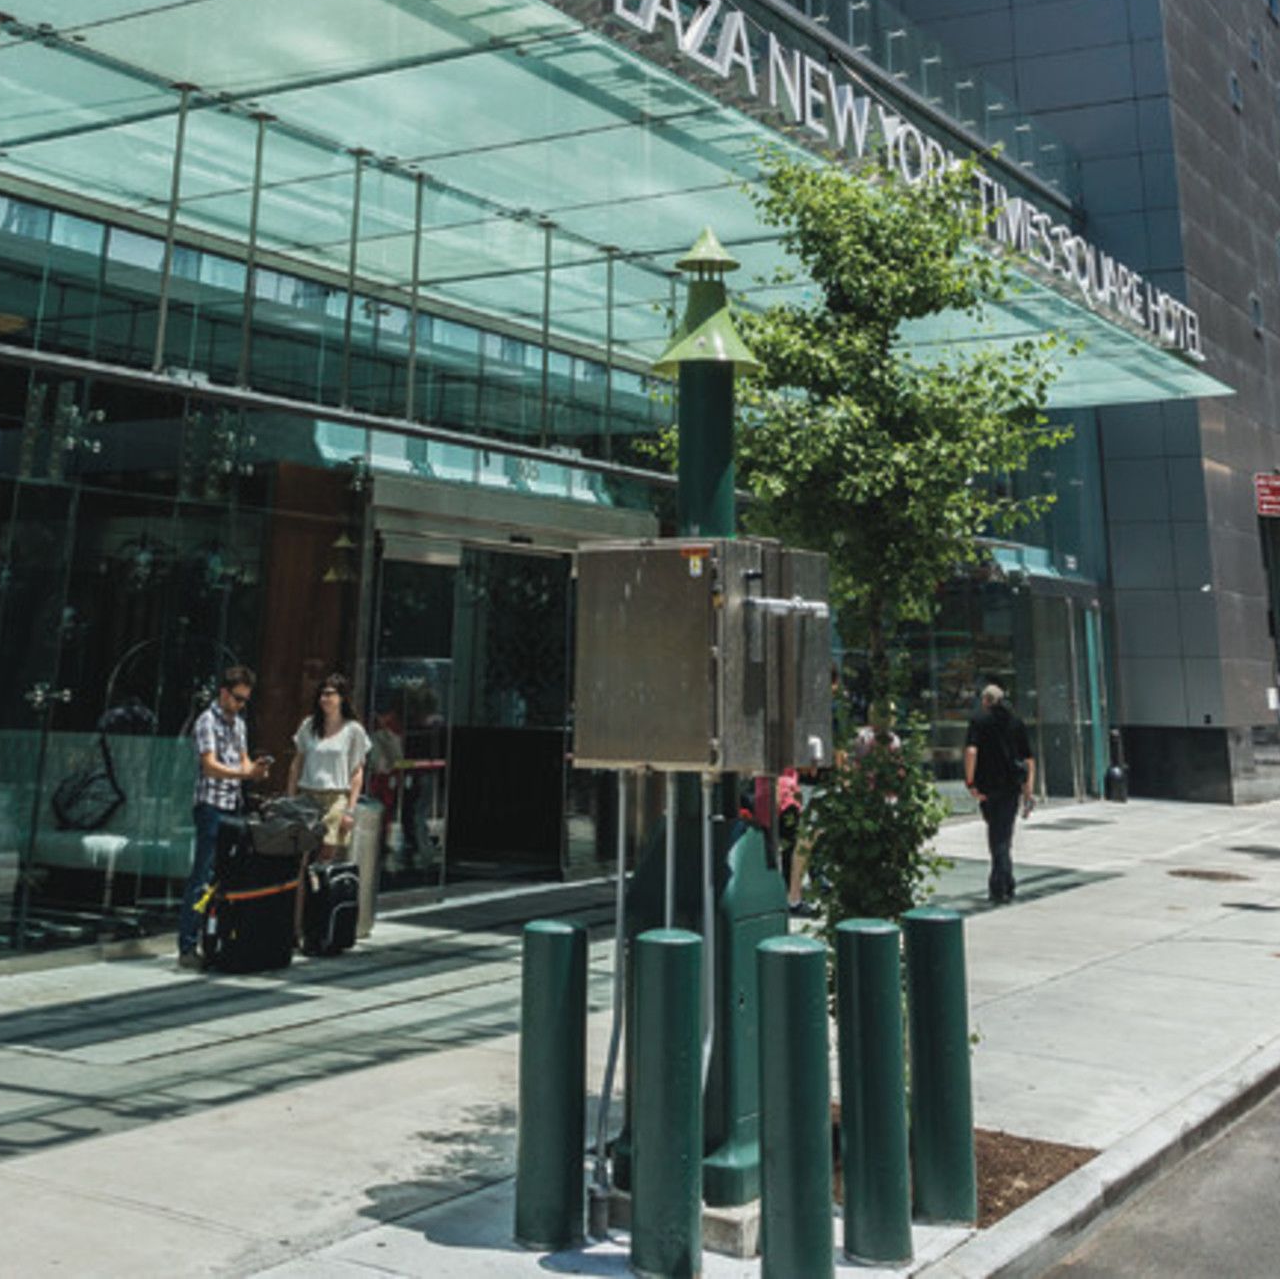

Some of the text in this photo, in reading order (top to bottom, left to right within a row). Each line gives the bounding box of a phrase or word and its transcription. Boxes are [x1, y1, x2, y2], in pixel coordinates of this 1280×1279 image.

[768, 32, 871, 158] NEW
[877, 105, 972, 211] YOR
[972, 167, 1055, 271] TIMES
[1050, 224, 1145, 325] SQUARE
[1145, 281, 1206, 361] HOTEL
